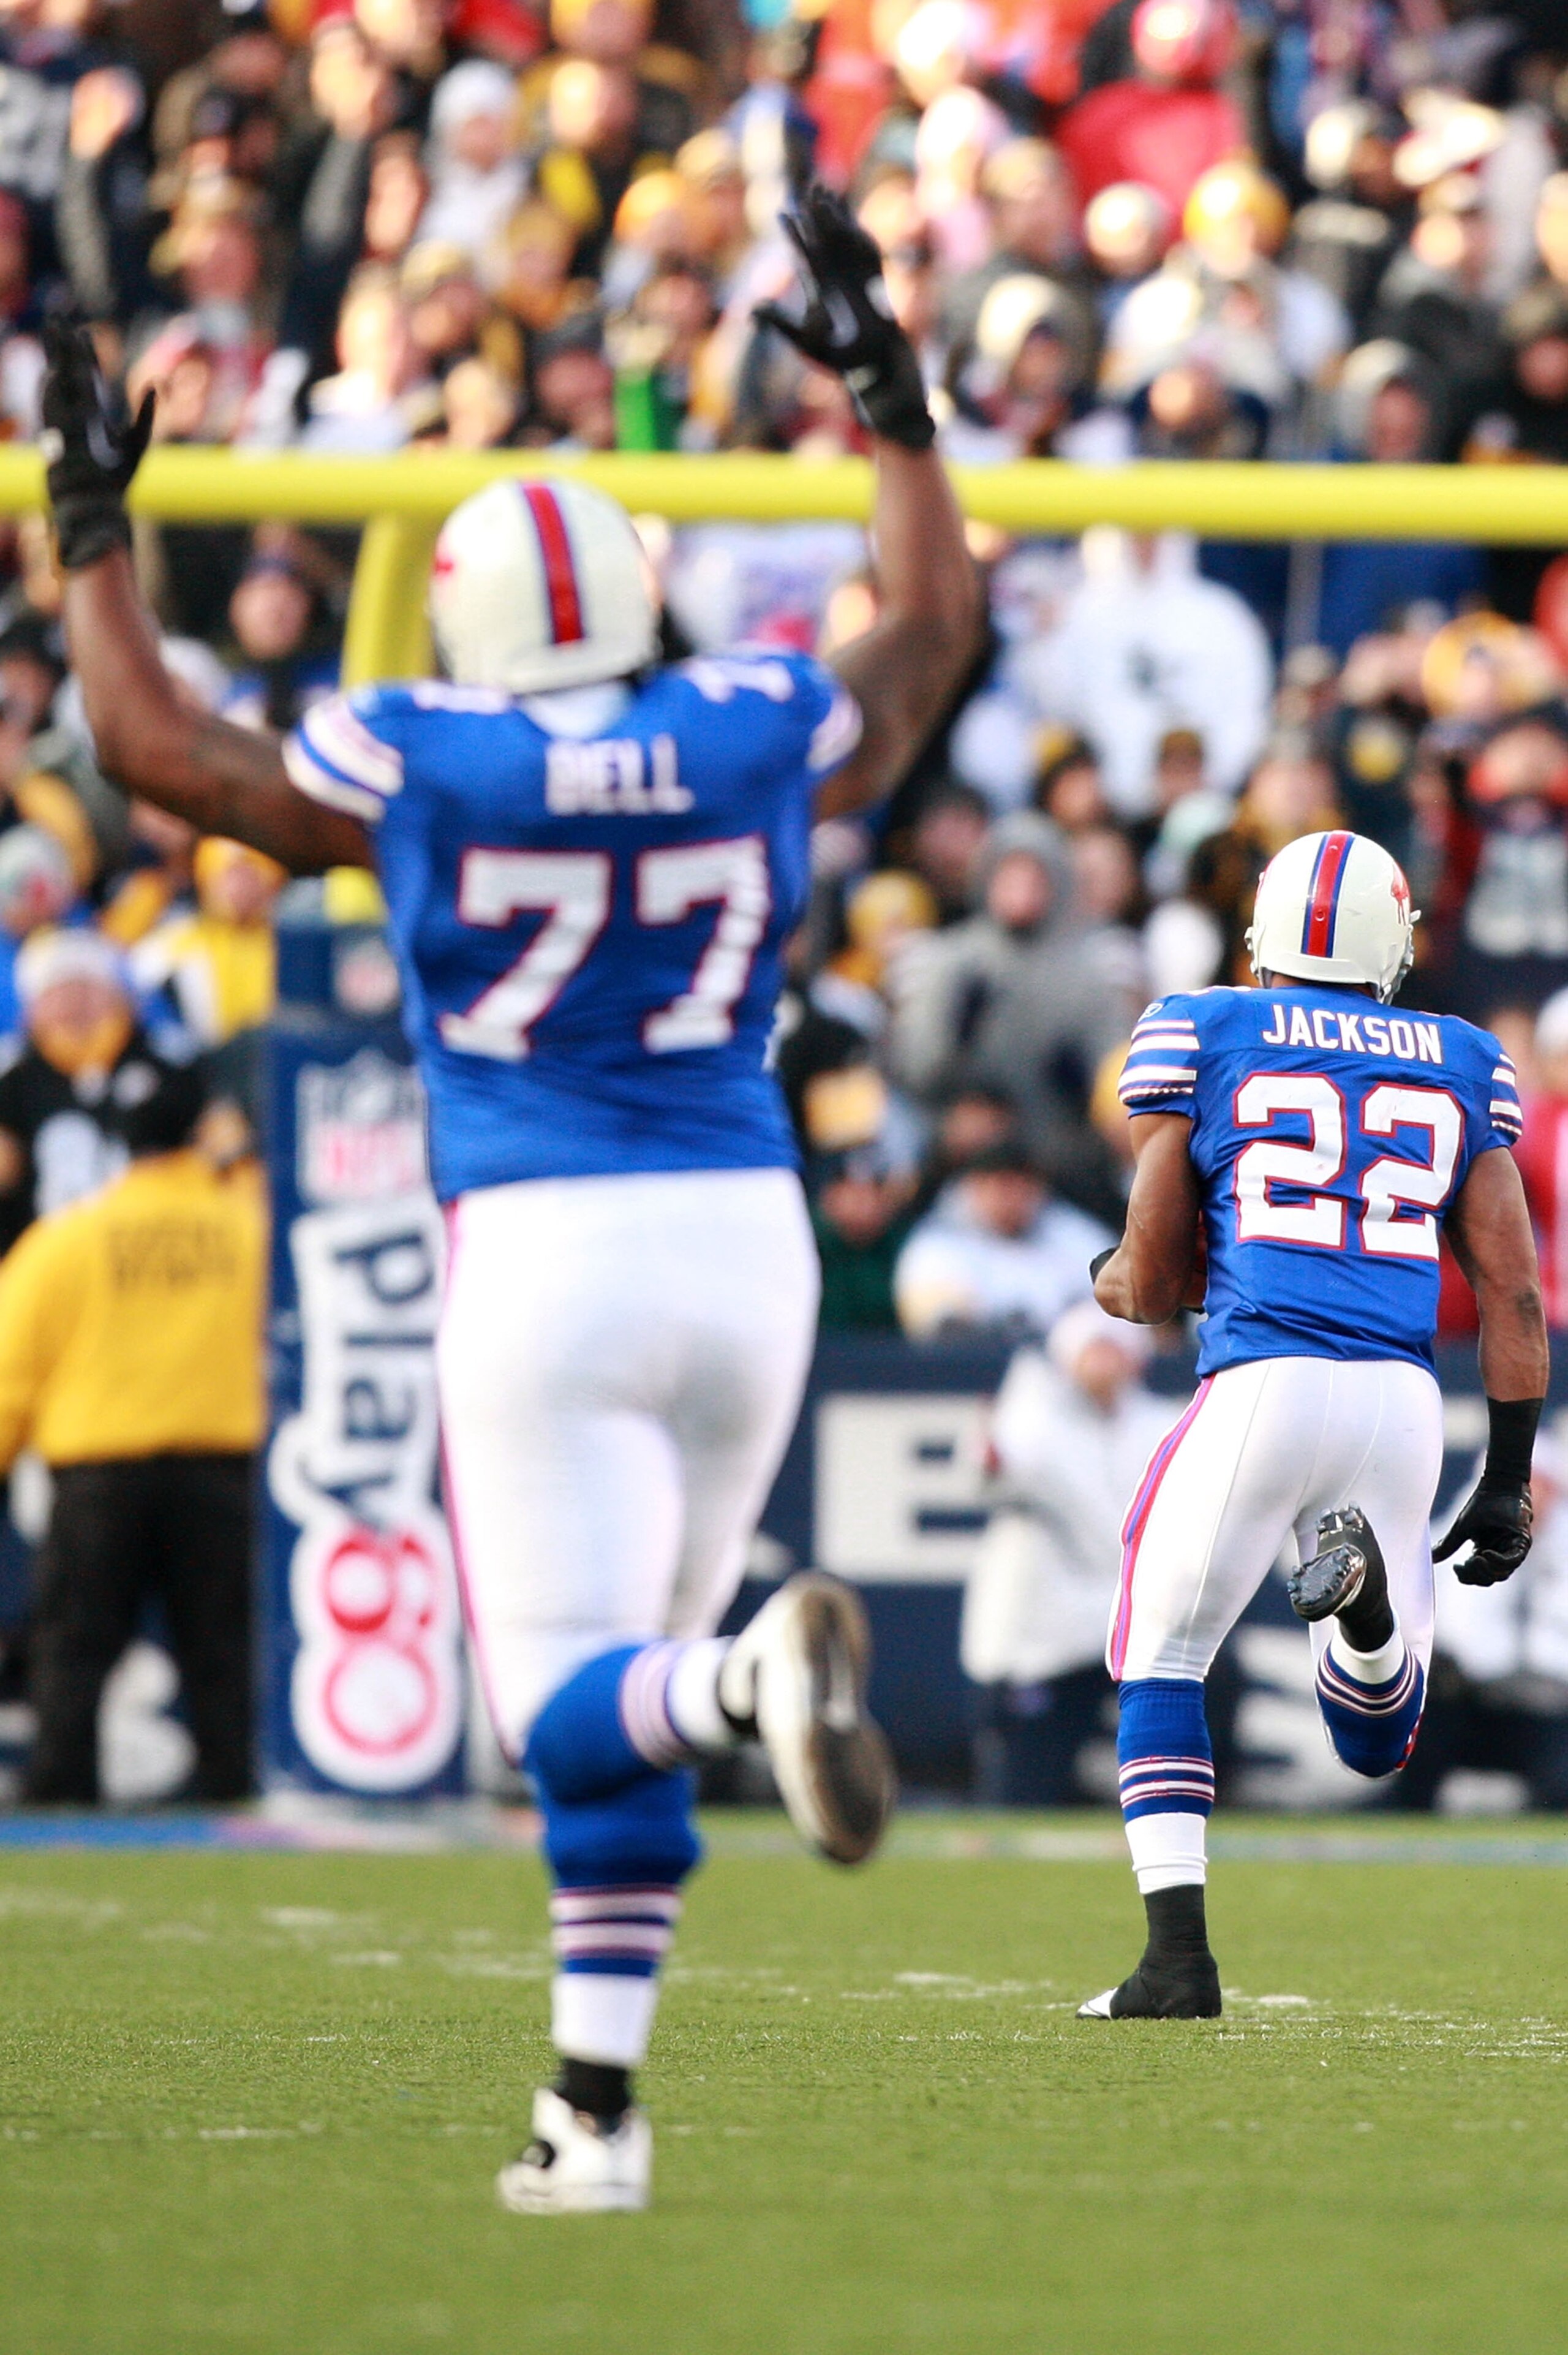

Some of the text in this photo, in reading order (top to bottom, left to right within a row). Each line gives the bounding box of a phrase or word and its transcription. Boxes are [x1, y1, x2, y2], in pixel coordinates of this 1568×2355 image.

[436, 833, 771, 1064] 77
[1262, 1004, 1442, 1064] JACKSON
[1233, 1071, 1466, 1261] 22
[296, 1231, 435, 1525] Play
